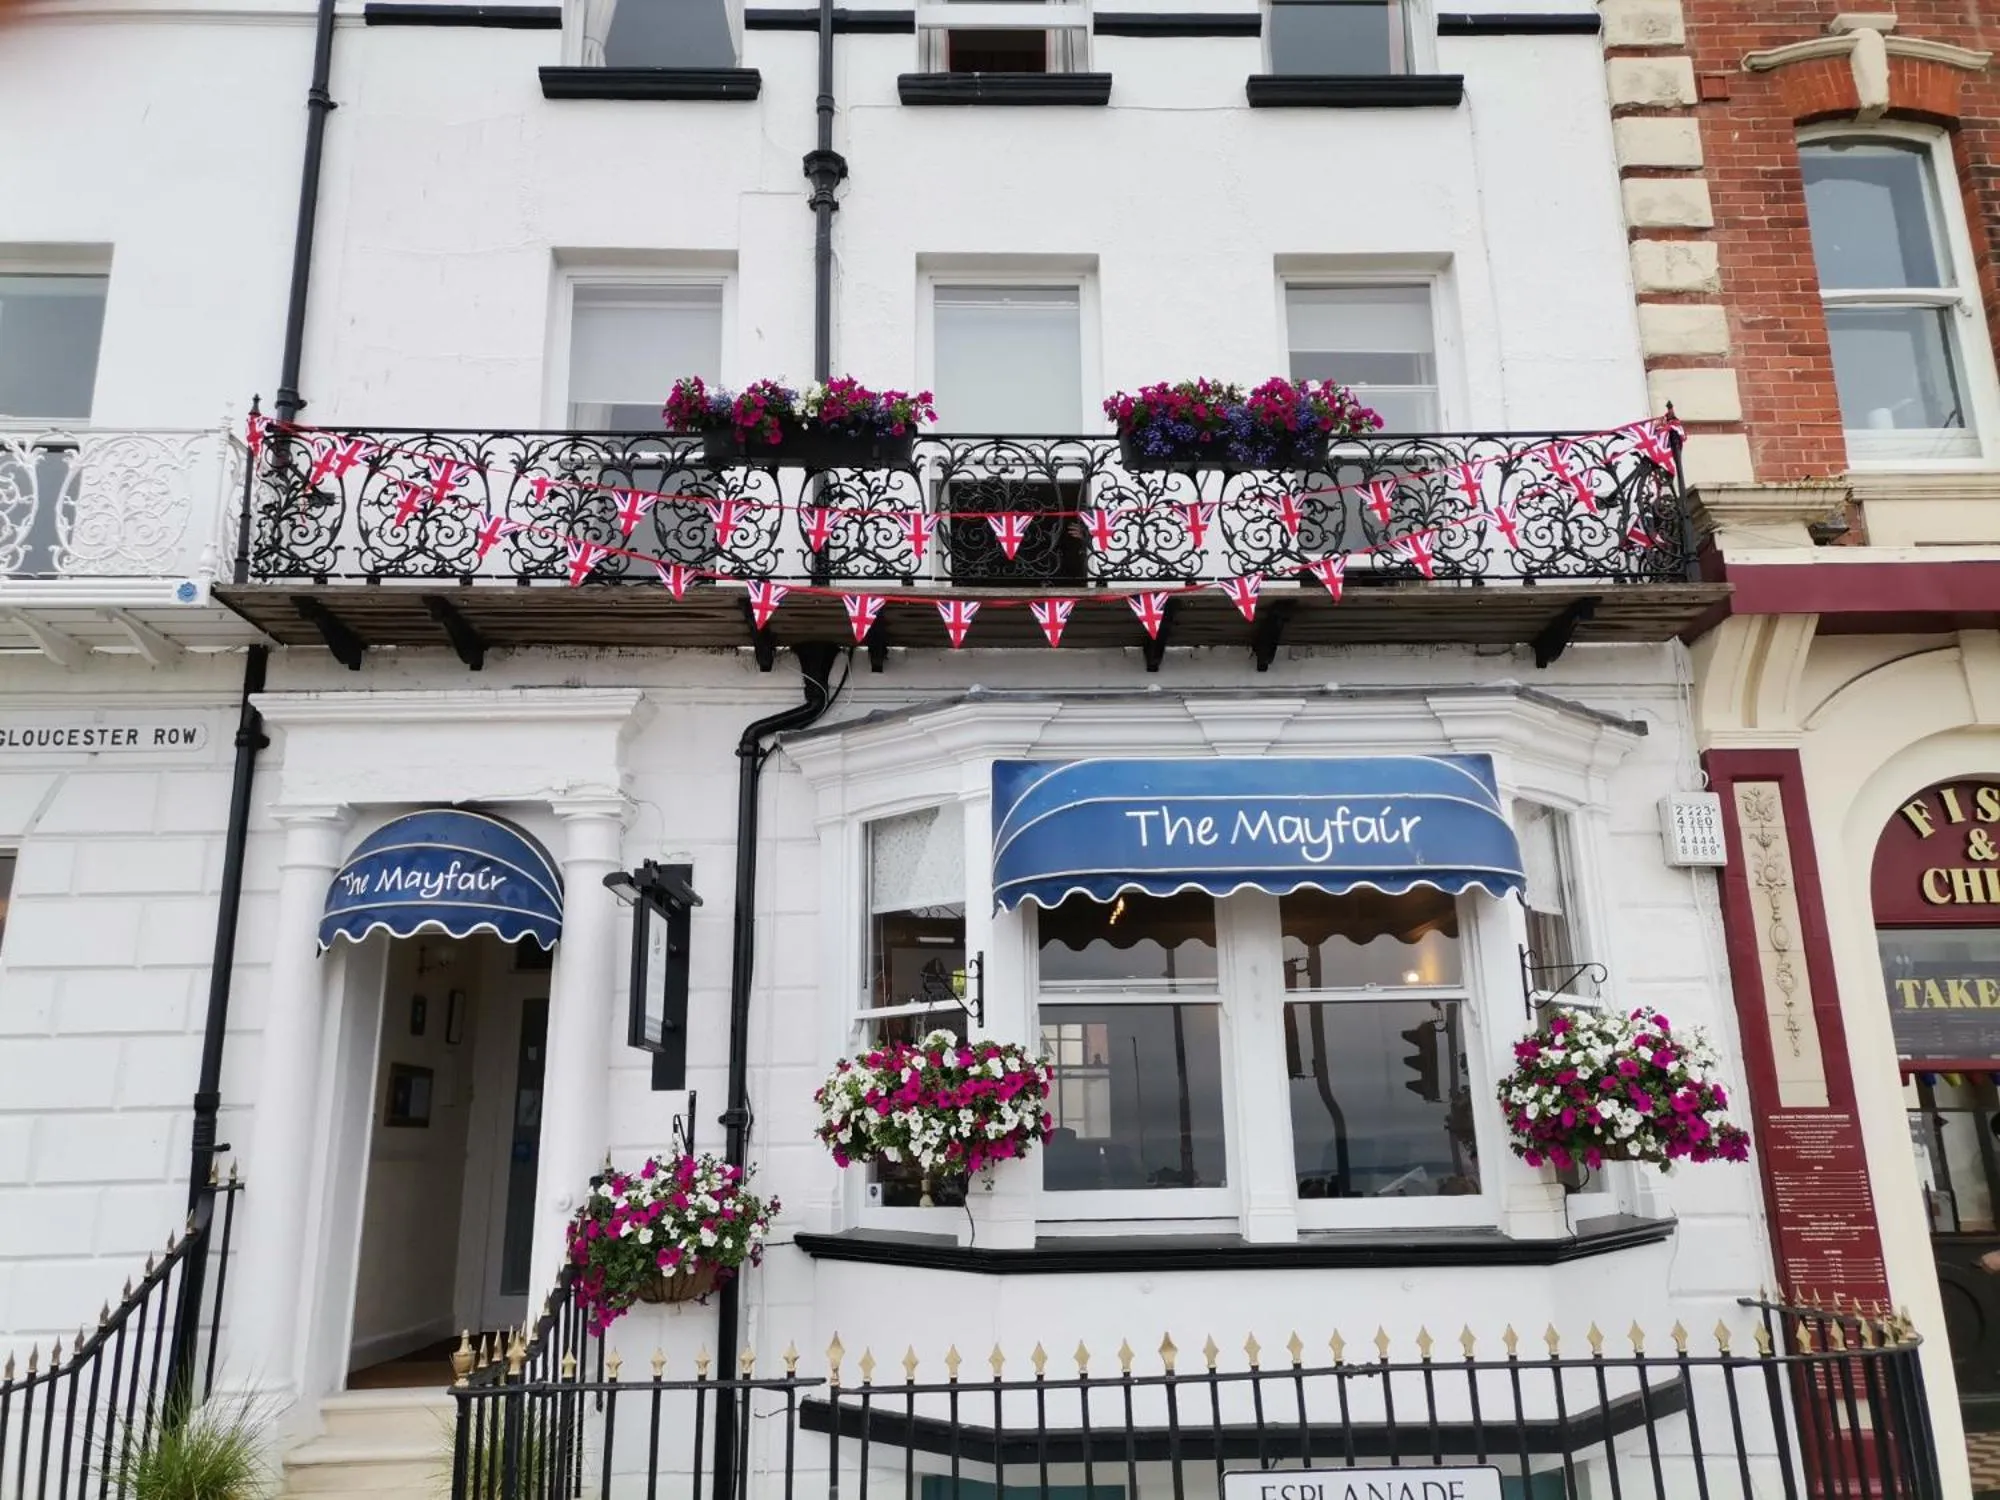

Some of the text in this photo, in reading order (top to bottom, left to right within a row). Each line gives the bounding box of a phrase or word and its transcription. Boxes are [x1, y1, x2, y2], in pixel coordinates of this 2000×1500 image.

[153, 727, 197, 745] ROW
[1125, 805, 1421, 863] The Mayfair
[1968, 827, 2000, 861] &
[341, 860, 507, 899] The Mayfair
